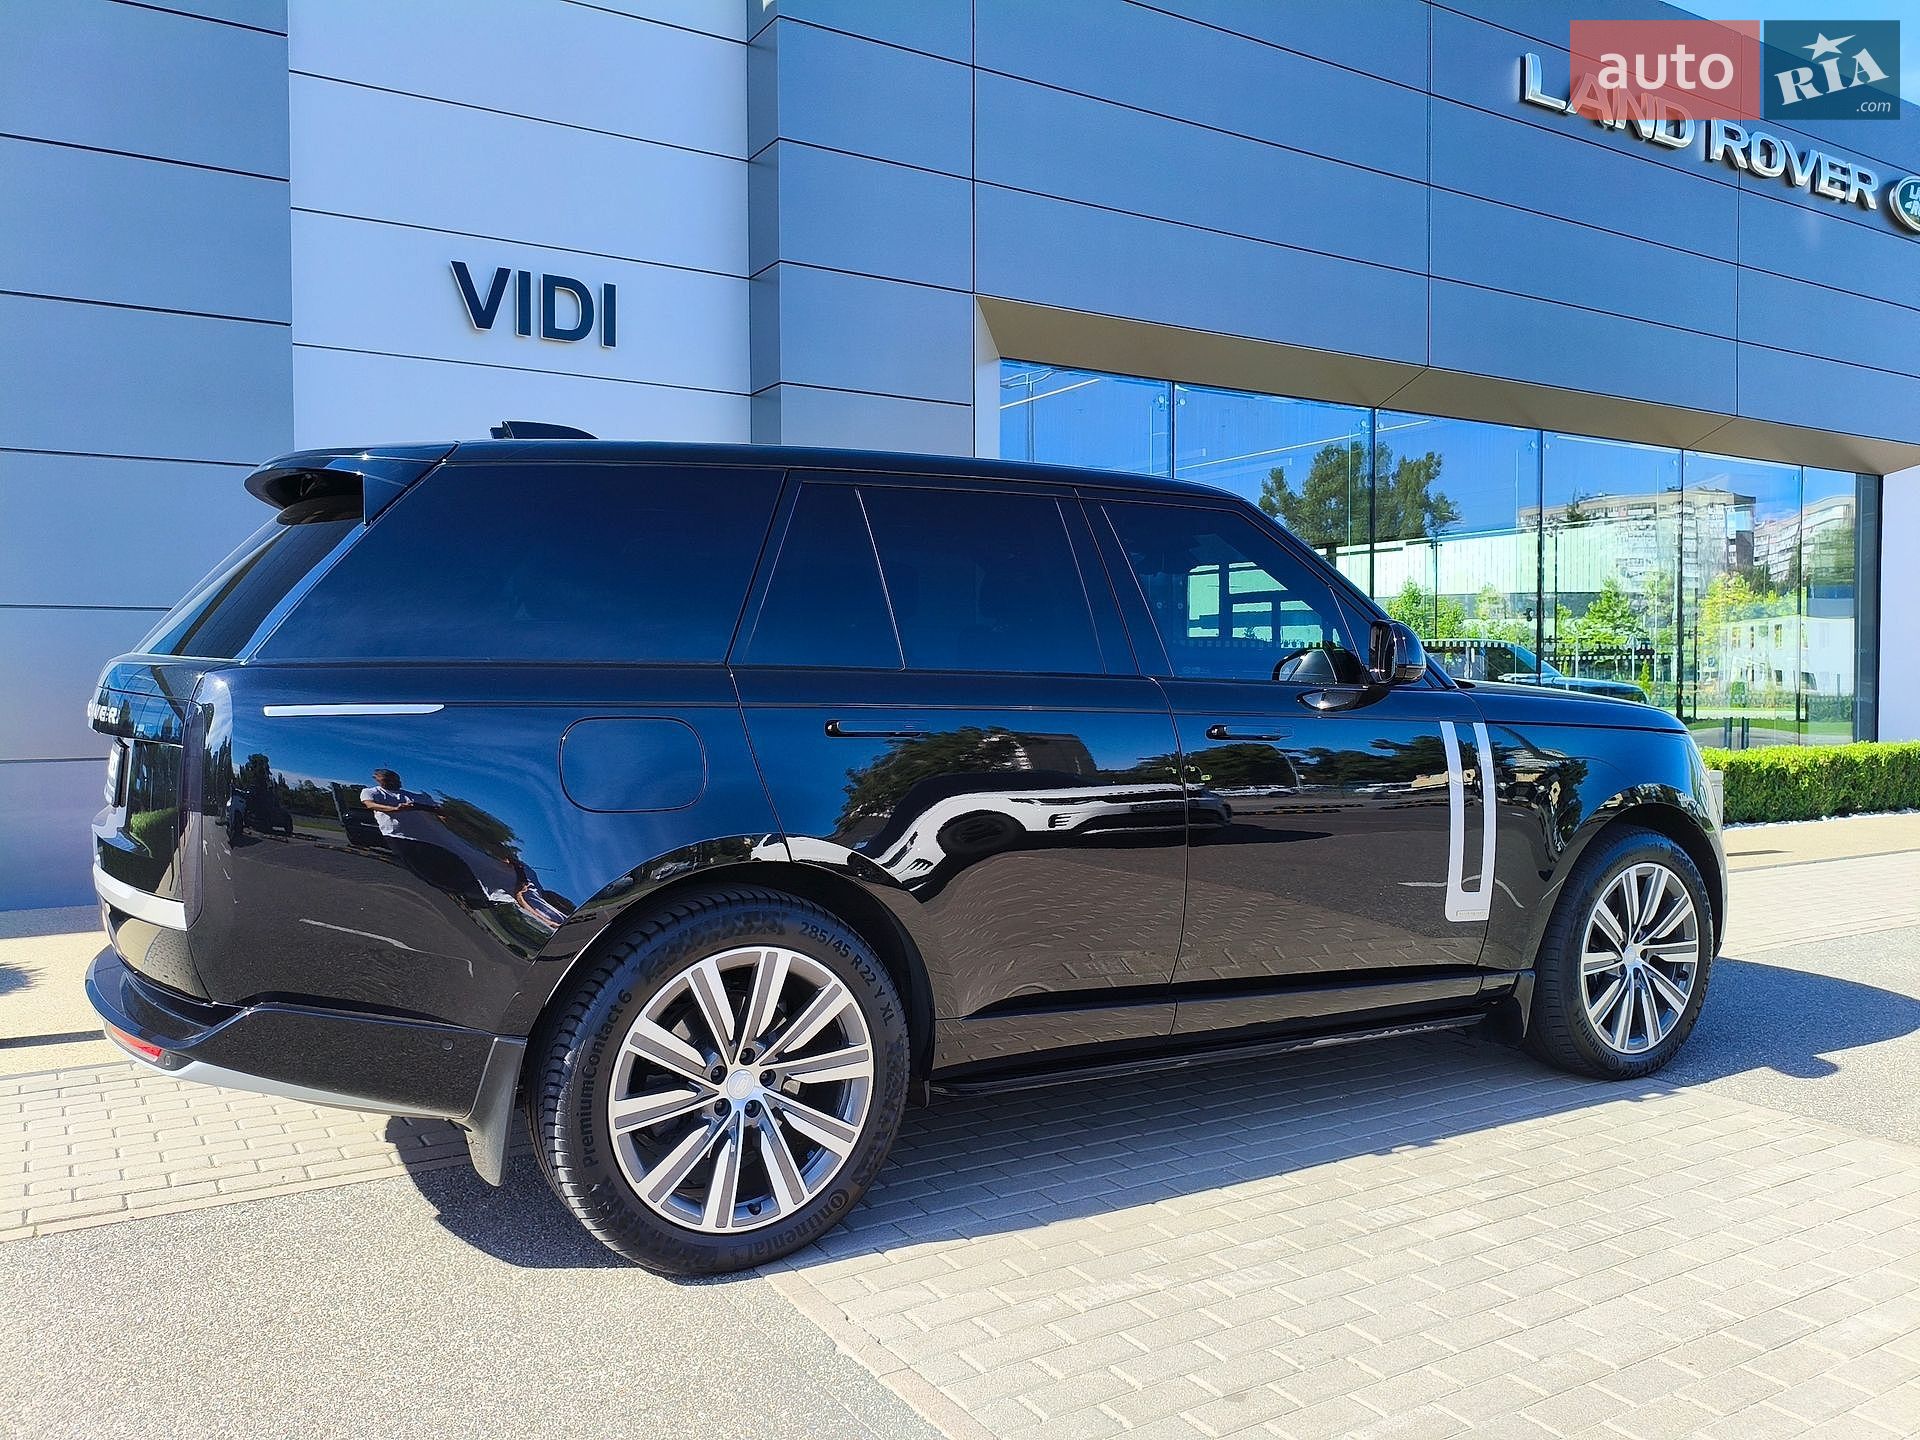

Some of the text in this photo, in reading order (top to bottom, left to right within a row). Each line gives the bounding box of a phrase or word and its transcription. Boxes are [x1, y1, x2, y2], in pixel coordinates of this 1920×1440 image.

[1519, 52, 1879, 210] LAND ROVER
[450, 260, 617, 348] VIDI
[800, 921, 852, 958] 285/45
[874, 985, 886, 999] Y
[879, 1001, 895, 1027] XL
[576, 988, 633, 1169] PremiumContact 6
[748, 1187, 851, 1261] Continental
